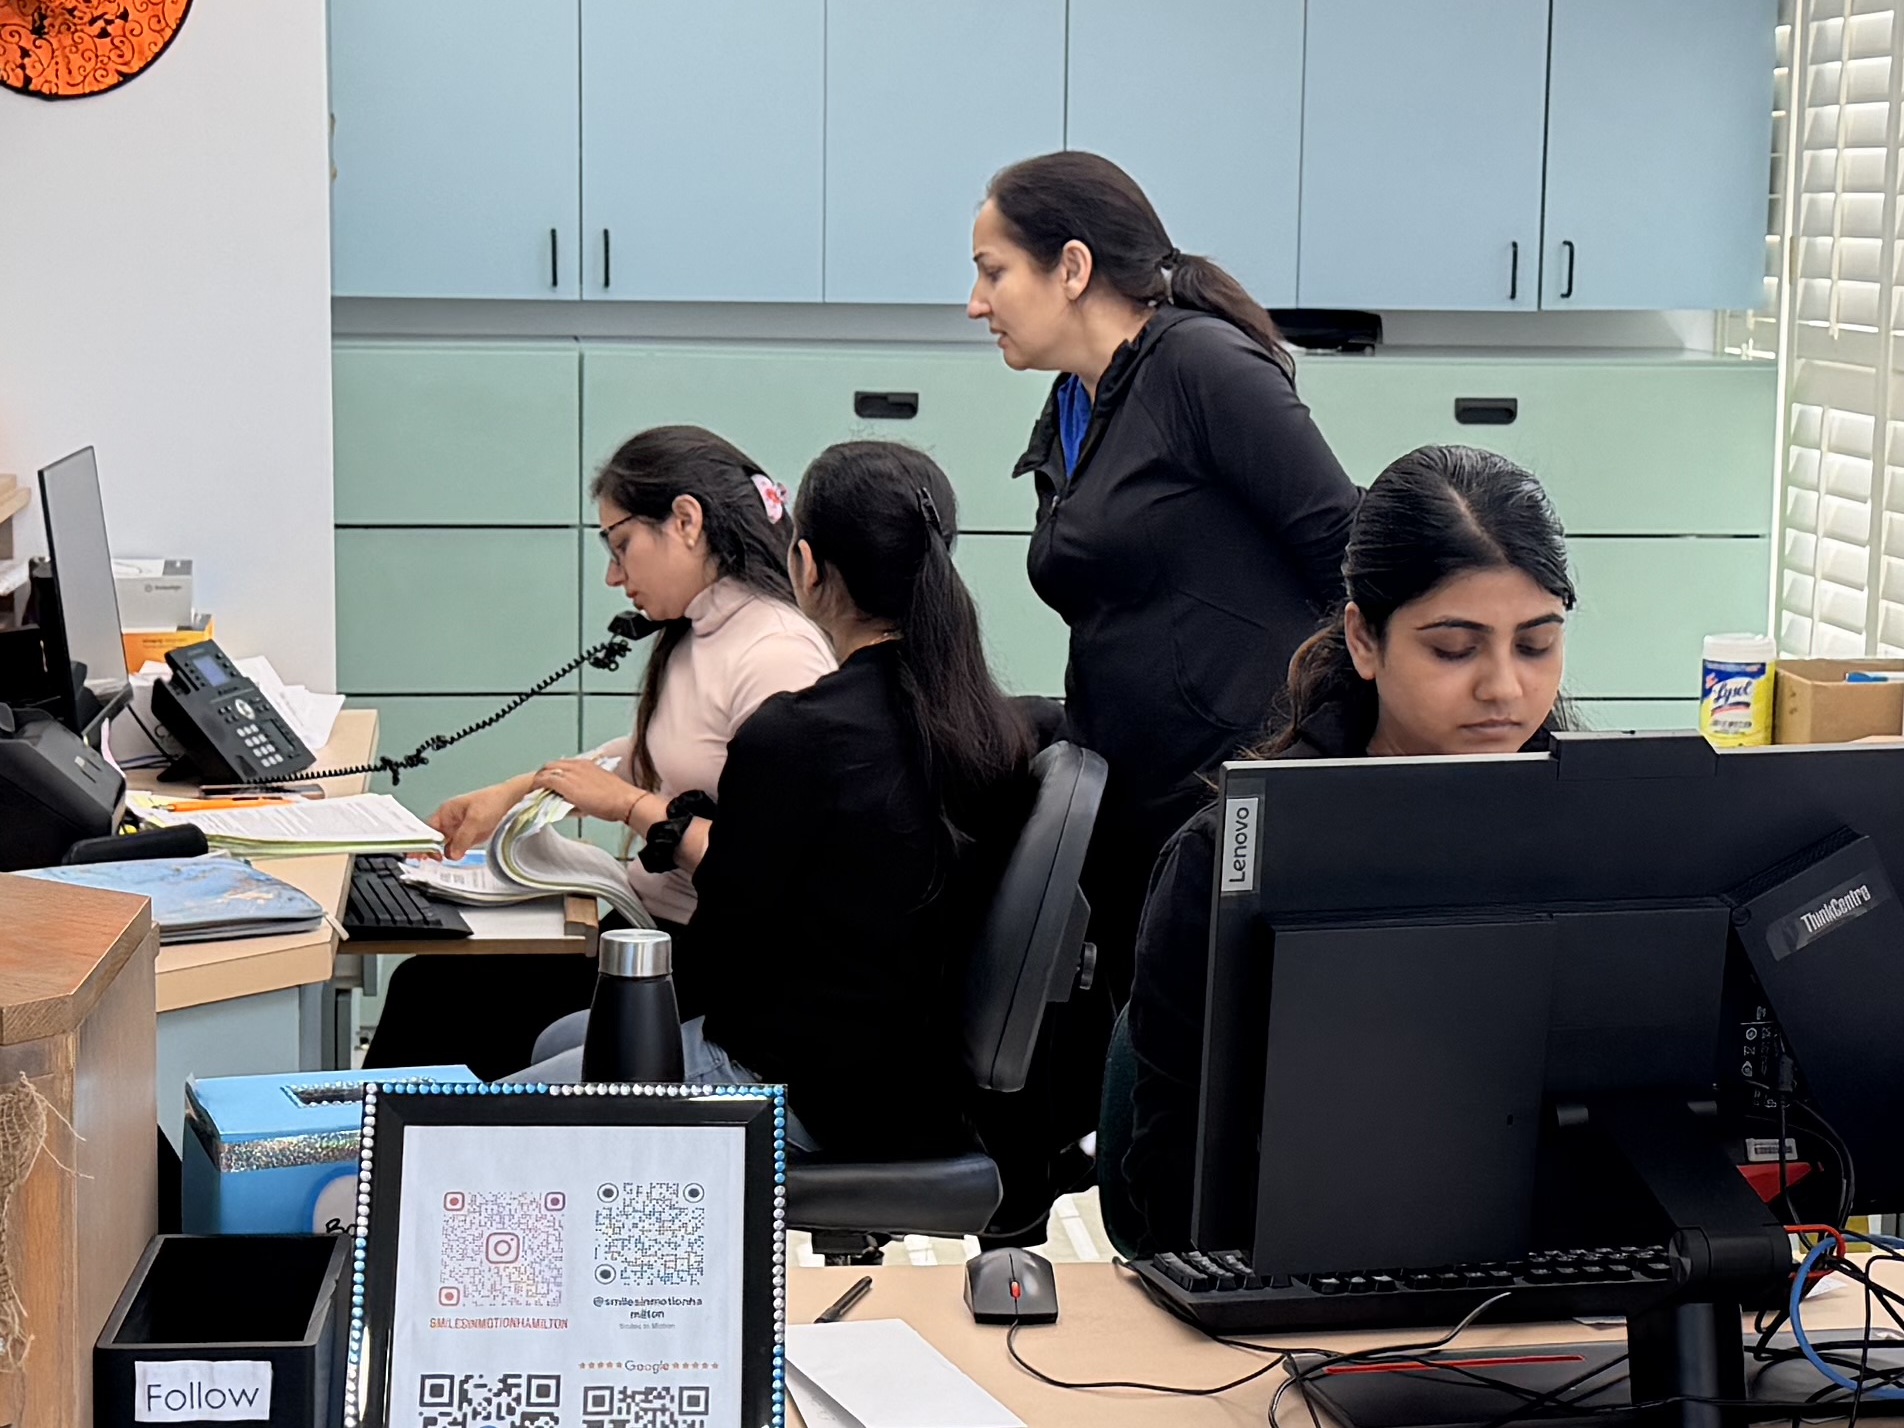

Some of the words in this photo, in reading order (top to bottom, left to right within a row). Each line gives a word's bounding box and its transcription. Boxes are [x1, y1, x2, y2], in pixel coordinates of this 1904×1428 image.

[1713, 679, 1753, 705] Lysol
[1228, 807, 1250, 882] Lenovo
[1800, 884, 1871, 933] ThinkCentre
[625, 1359, 670, 1374] Google
[147, 1381, 260, 1412] Follow
